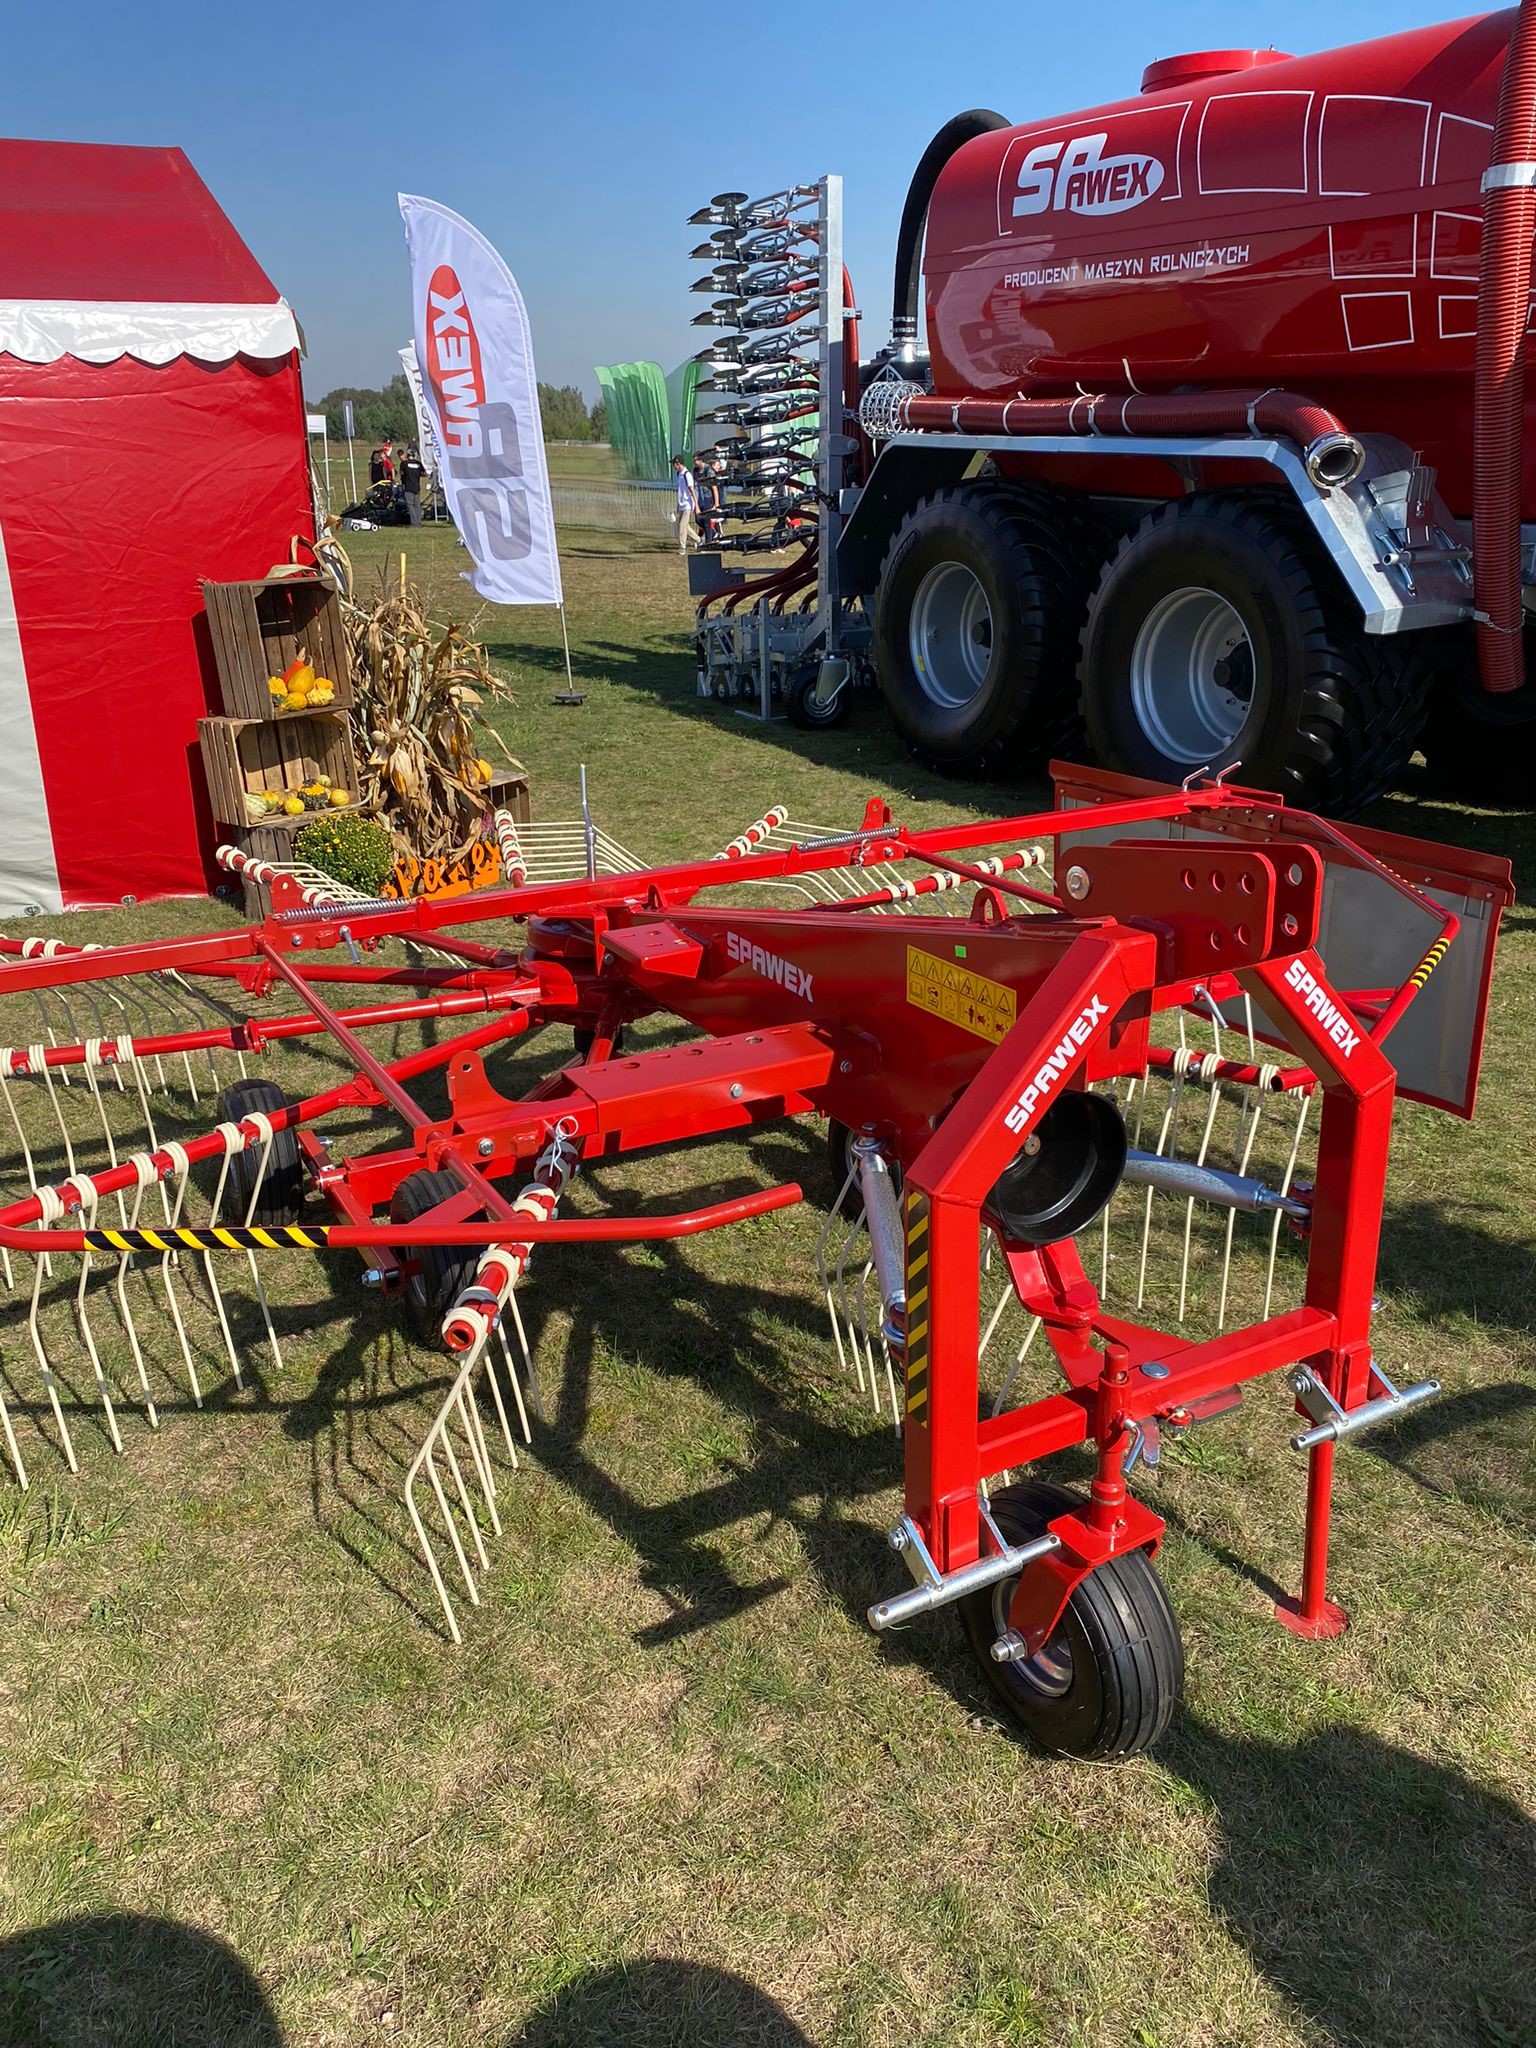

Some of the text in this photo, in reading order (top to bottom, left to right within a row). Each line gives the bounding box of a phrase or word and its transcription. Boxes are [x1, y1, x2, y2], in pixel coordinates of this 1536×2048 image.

[1004, 244, 1250, 289] PRODUCENT MASZYN ROLNICZYCH
[727, 930, 814, 1004] SPAWEX
[1283, 958, 1361, 1059] SPAWEX
[1003, 993, 1110, 1135] SPAWEX
